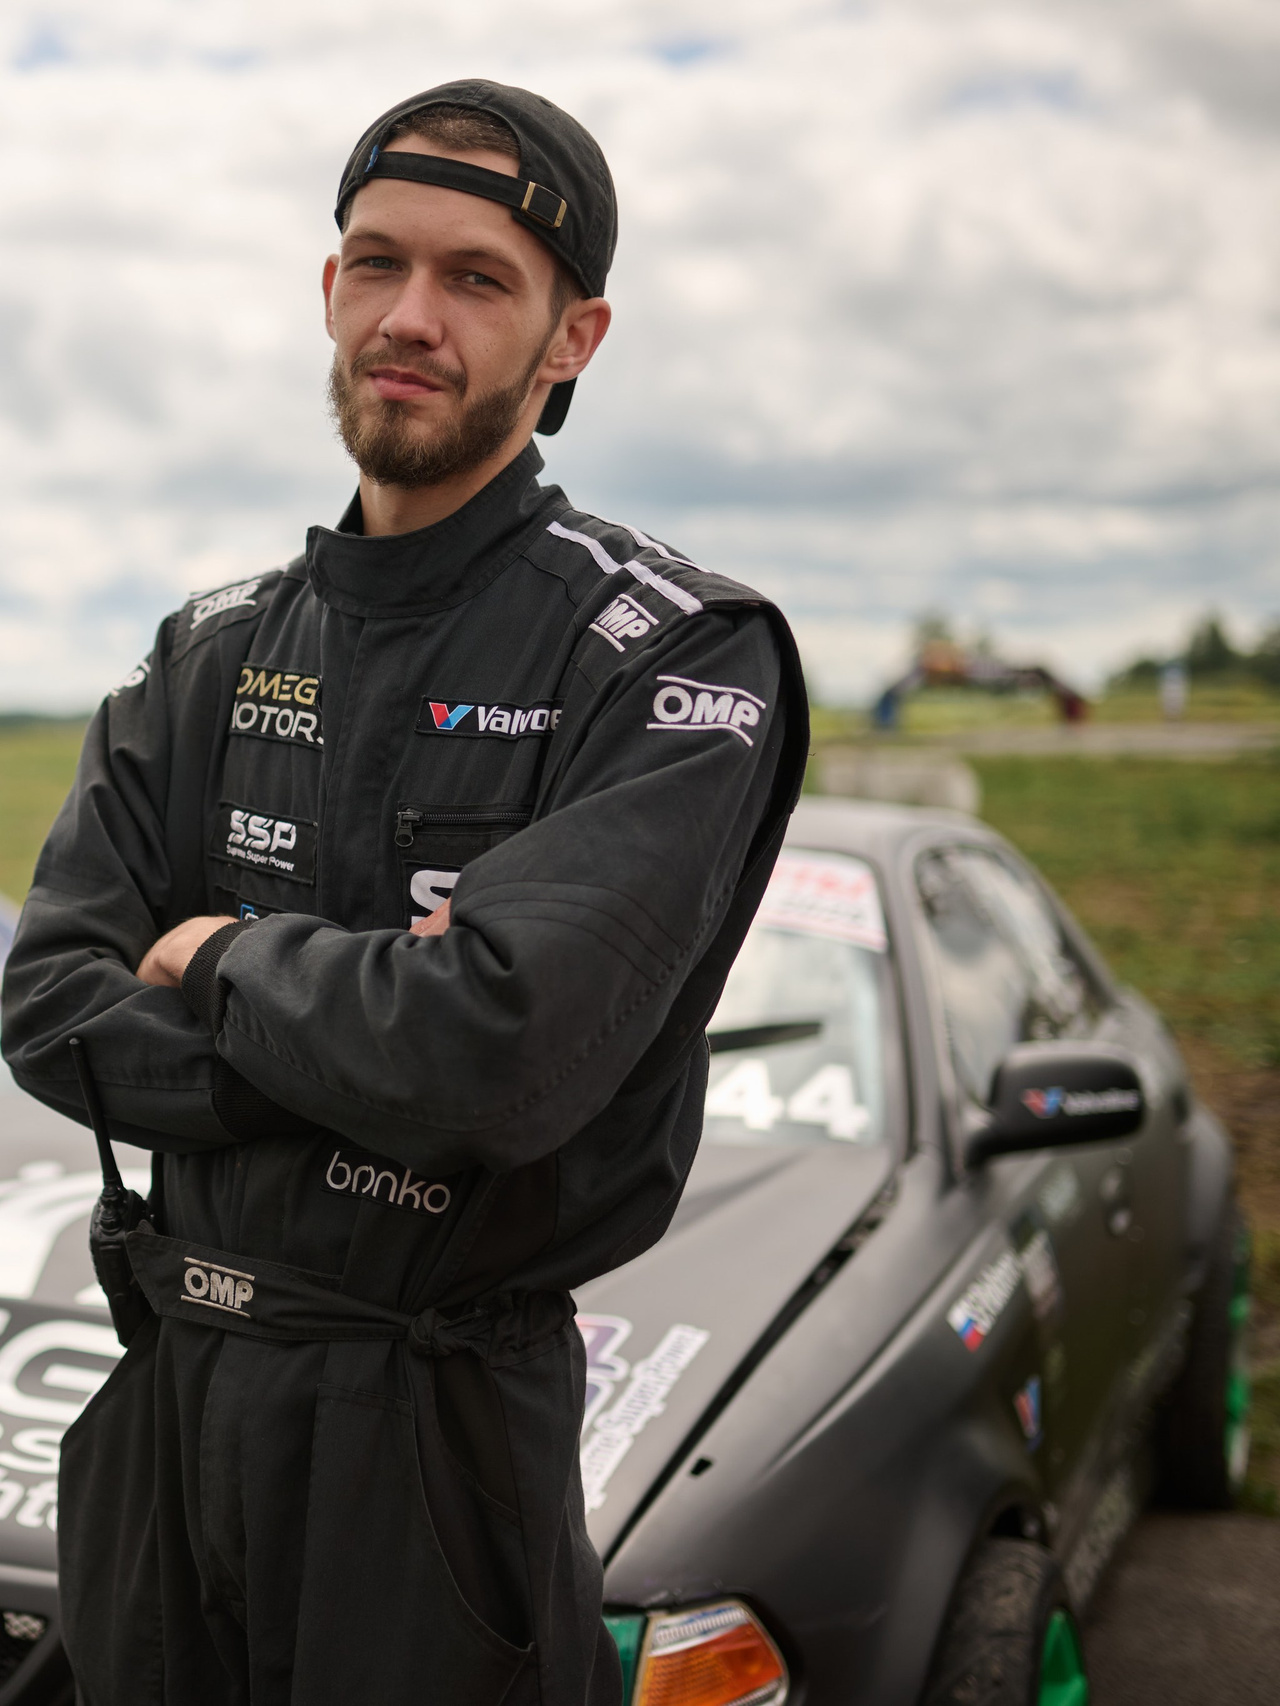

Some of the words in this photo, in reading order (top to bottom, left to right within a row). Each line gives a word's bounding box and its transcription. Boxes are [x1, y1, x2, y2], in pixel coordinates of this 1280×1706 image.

[193, 584, 259, 621] OMP
[231, 701, 324, 745] OTOR
[653, 685, 760, 728] OMP
[227, 809, 297, 853] SSP
[268, 856, 295, 872] Power
[704, 1057, 870, 1143] 44
[184, 1266, 254, 1309] OMP
